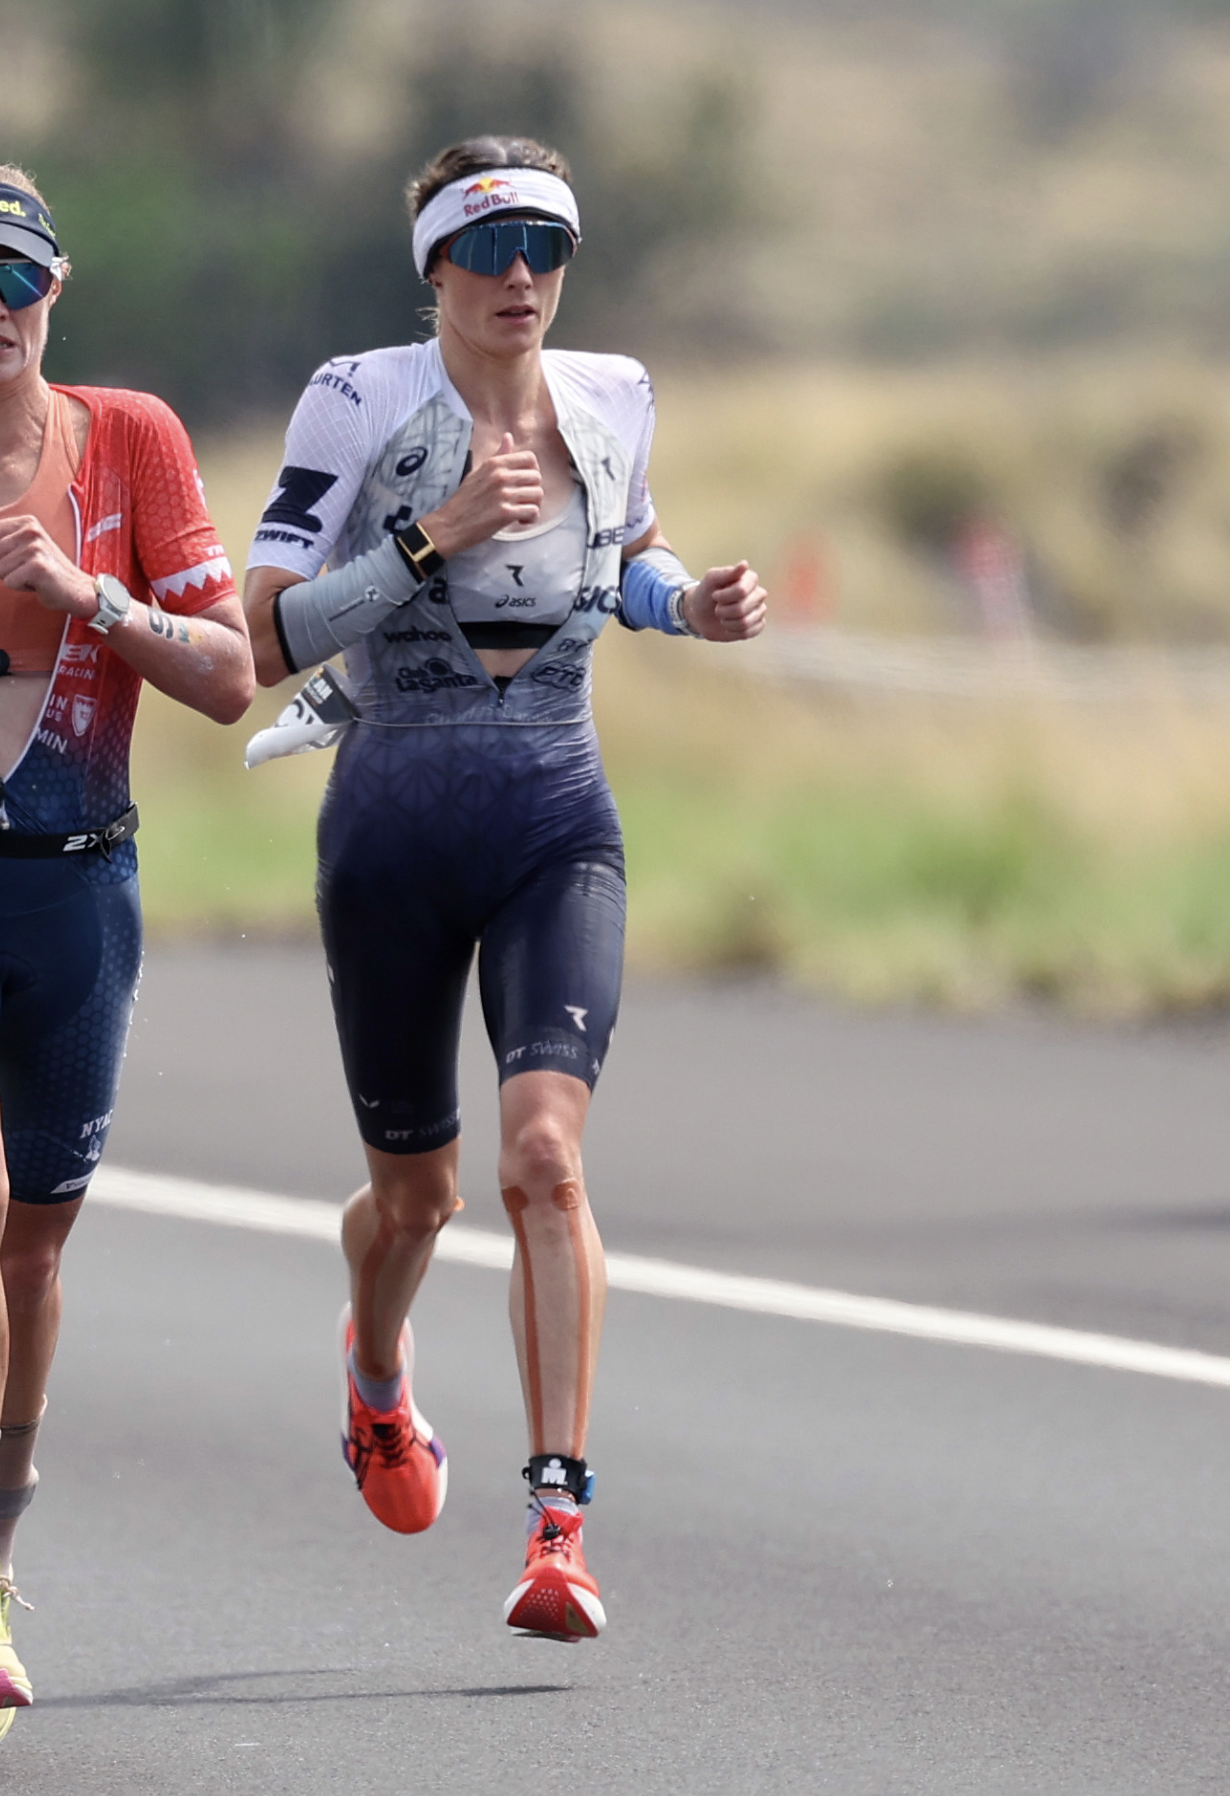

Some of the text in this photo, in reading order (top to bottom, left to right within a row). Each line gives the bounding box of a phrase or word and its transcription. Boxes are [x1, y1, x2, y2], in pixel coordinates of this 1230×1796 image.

[463, 192, 520, 217] Red Bull
[309, 373, 362, 406] URTEN
[383, 625, 452, 643] wahoo
[58, 665, 95, 680] RACIN
[36, 726, 68, 754] MIN
[385, 1129, 414, 1141] DT
